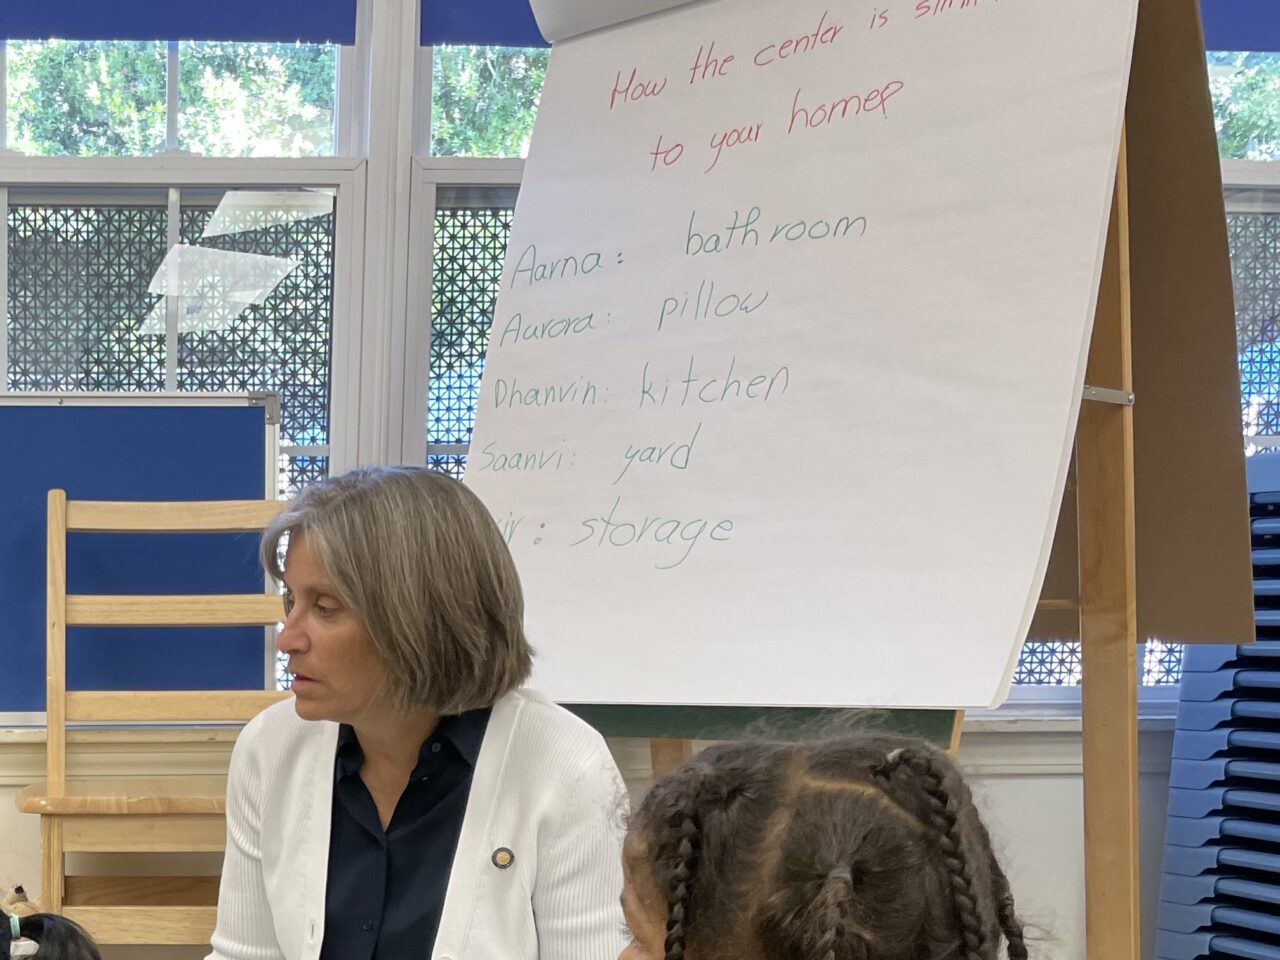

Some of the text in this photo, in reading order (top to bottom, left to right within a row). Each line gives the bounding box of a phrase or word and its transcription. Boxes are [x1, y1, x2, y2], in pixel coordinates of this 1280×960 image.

[610, 68, 667, 110] How
[689, 41, 734, 85] the
[754, 10, 844, 66] center
[870, 9, 888, 30] is
[650, 135, 684, 172] to
[705, 122, 763, 174] your
[658, 281, 768, 331] pillow
[640, 355, 789, 409] kitchen
[612, 422, 702, 486] yard
[571, 496, 734, 570] storage
